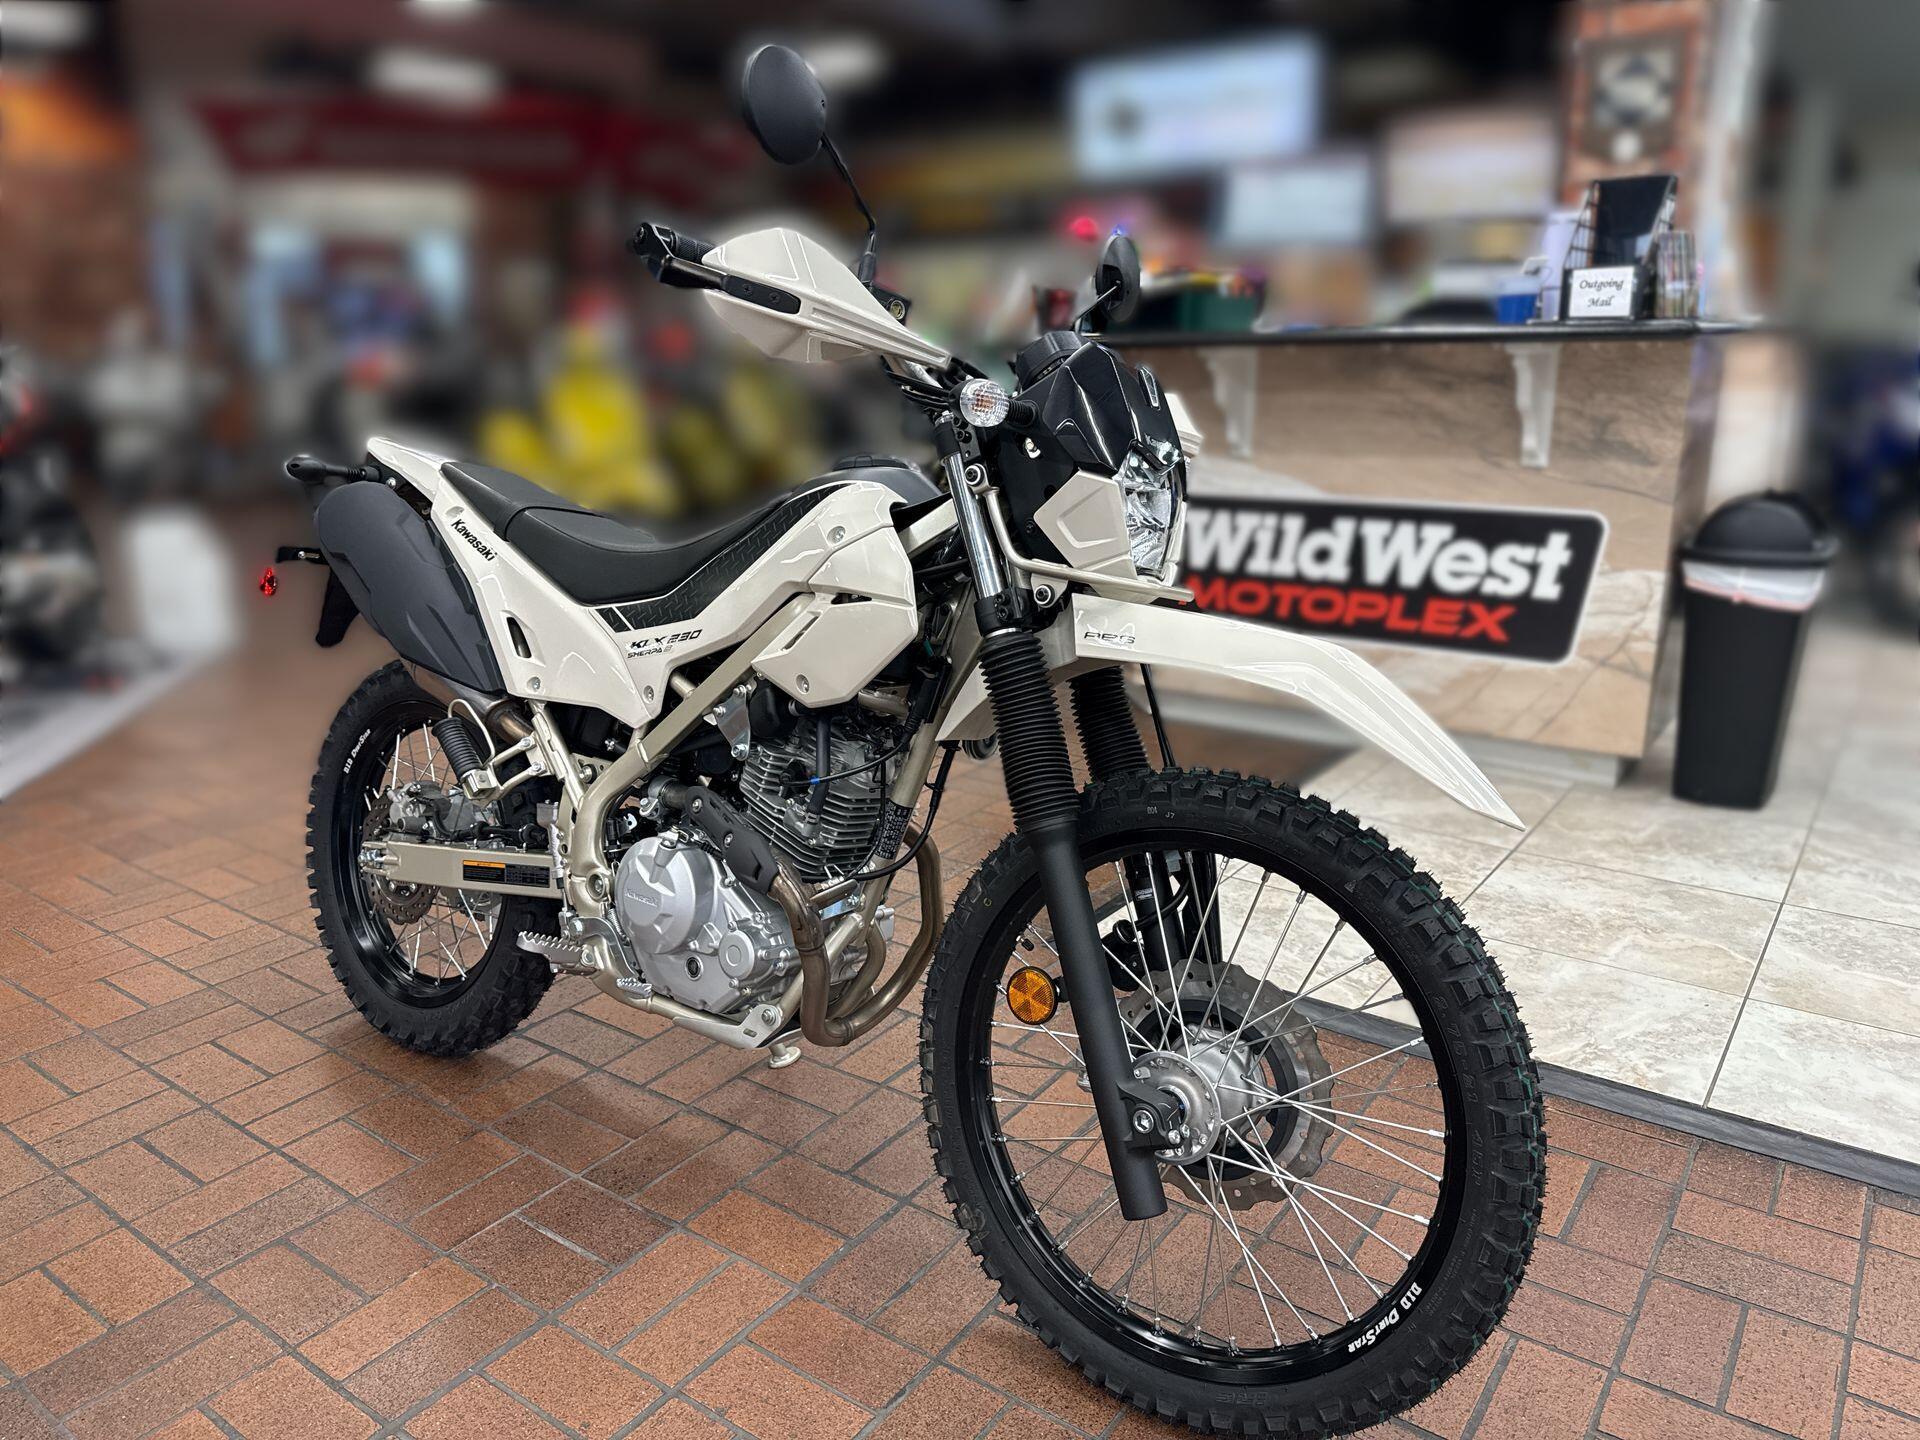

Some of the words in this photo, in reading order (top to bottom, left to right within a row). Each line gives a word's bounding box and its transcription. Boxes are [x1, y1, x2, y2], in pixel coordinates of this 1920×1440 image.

[1580, 278, 1624, 292] Outgoing
[1587, 295, 1615, 308] Mail
[451, 518, 498, 562] Kawasaki
[1178, 577, 1516, 643] MOTOPLEX
[667, 629, 703, 645] 230
[627, 647, 663, 659] SHERPA
[1400, 1281, 1423, 1310] DID
